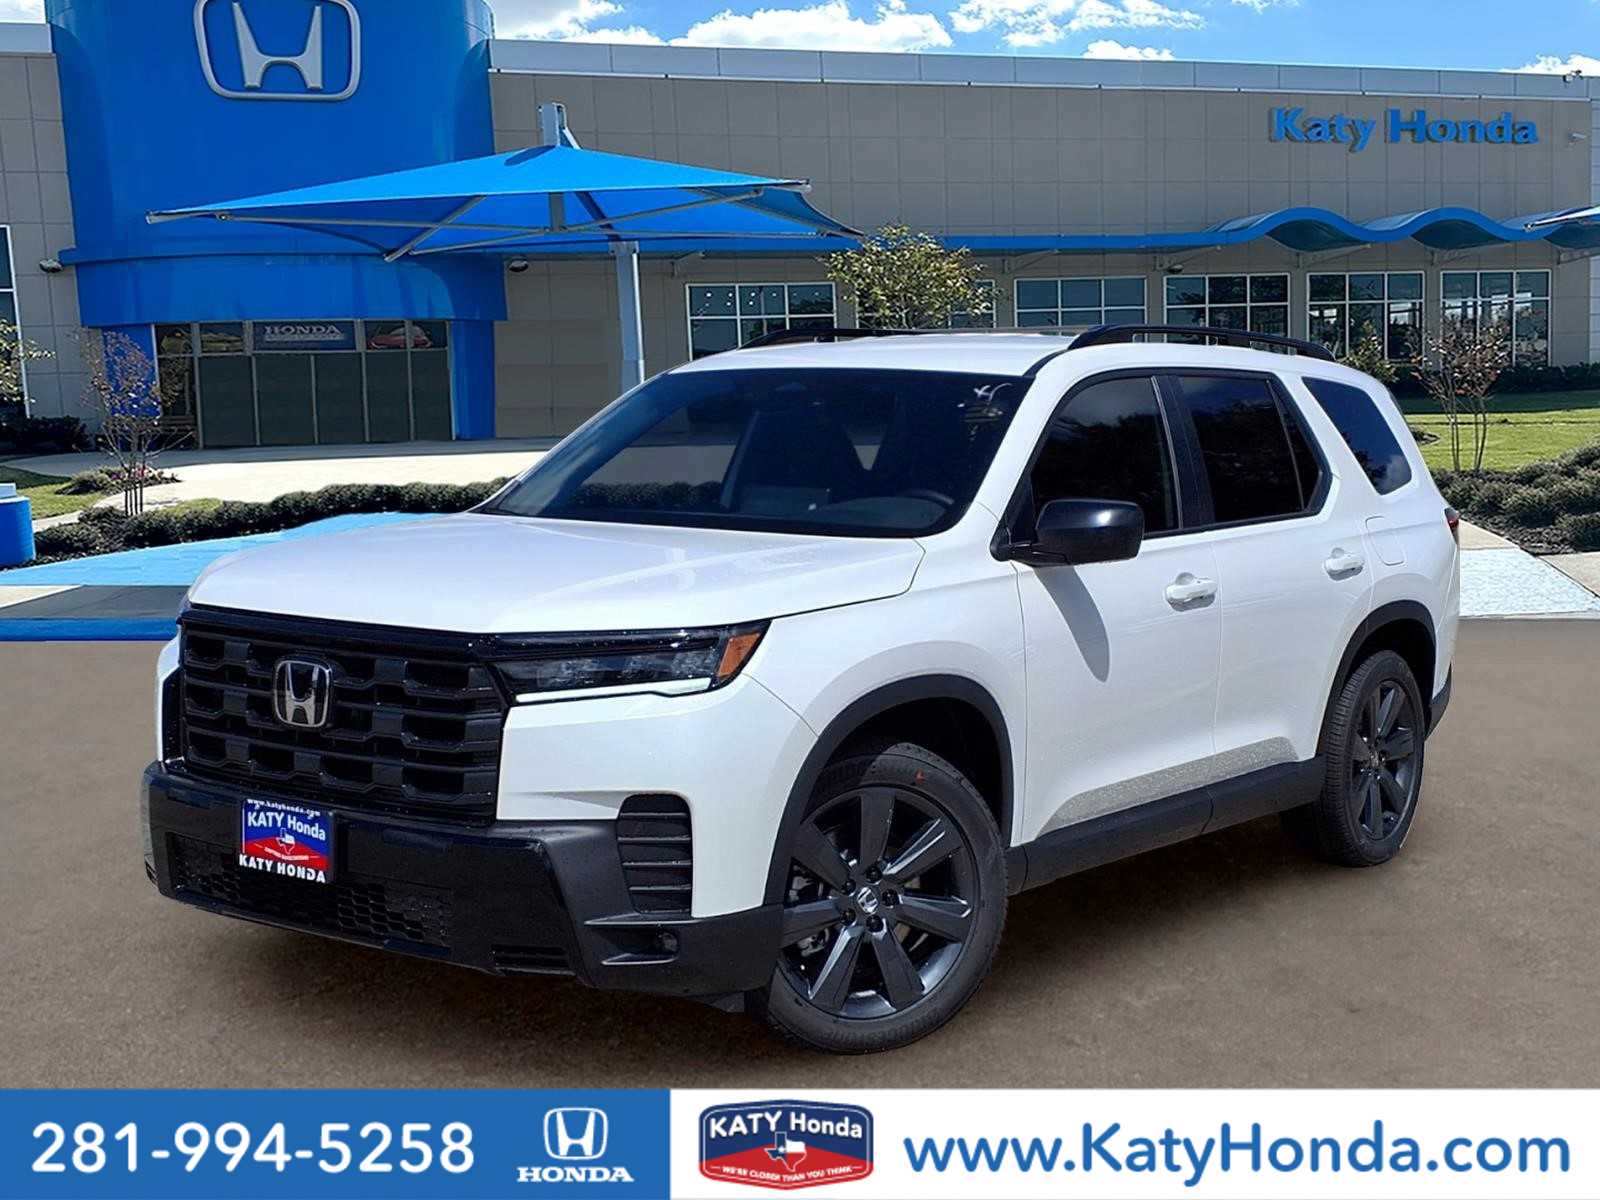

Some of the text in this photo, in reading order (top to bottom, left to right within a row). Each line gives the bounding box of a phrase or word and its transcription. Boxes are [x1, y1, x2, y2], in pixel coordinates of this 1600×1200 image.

[1269, 107, 1538, 152] Katy Honda
[264, 325, 342, 335] HONDA
[247, 812, 326, 841] KATY Honda
[239, 854, 273, 872] KATY
[277, 862, 326, 883] HONDA
